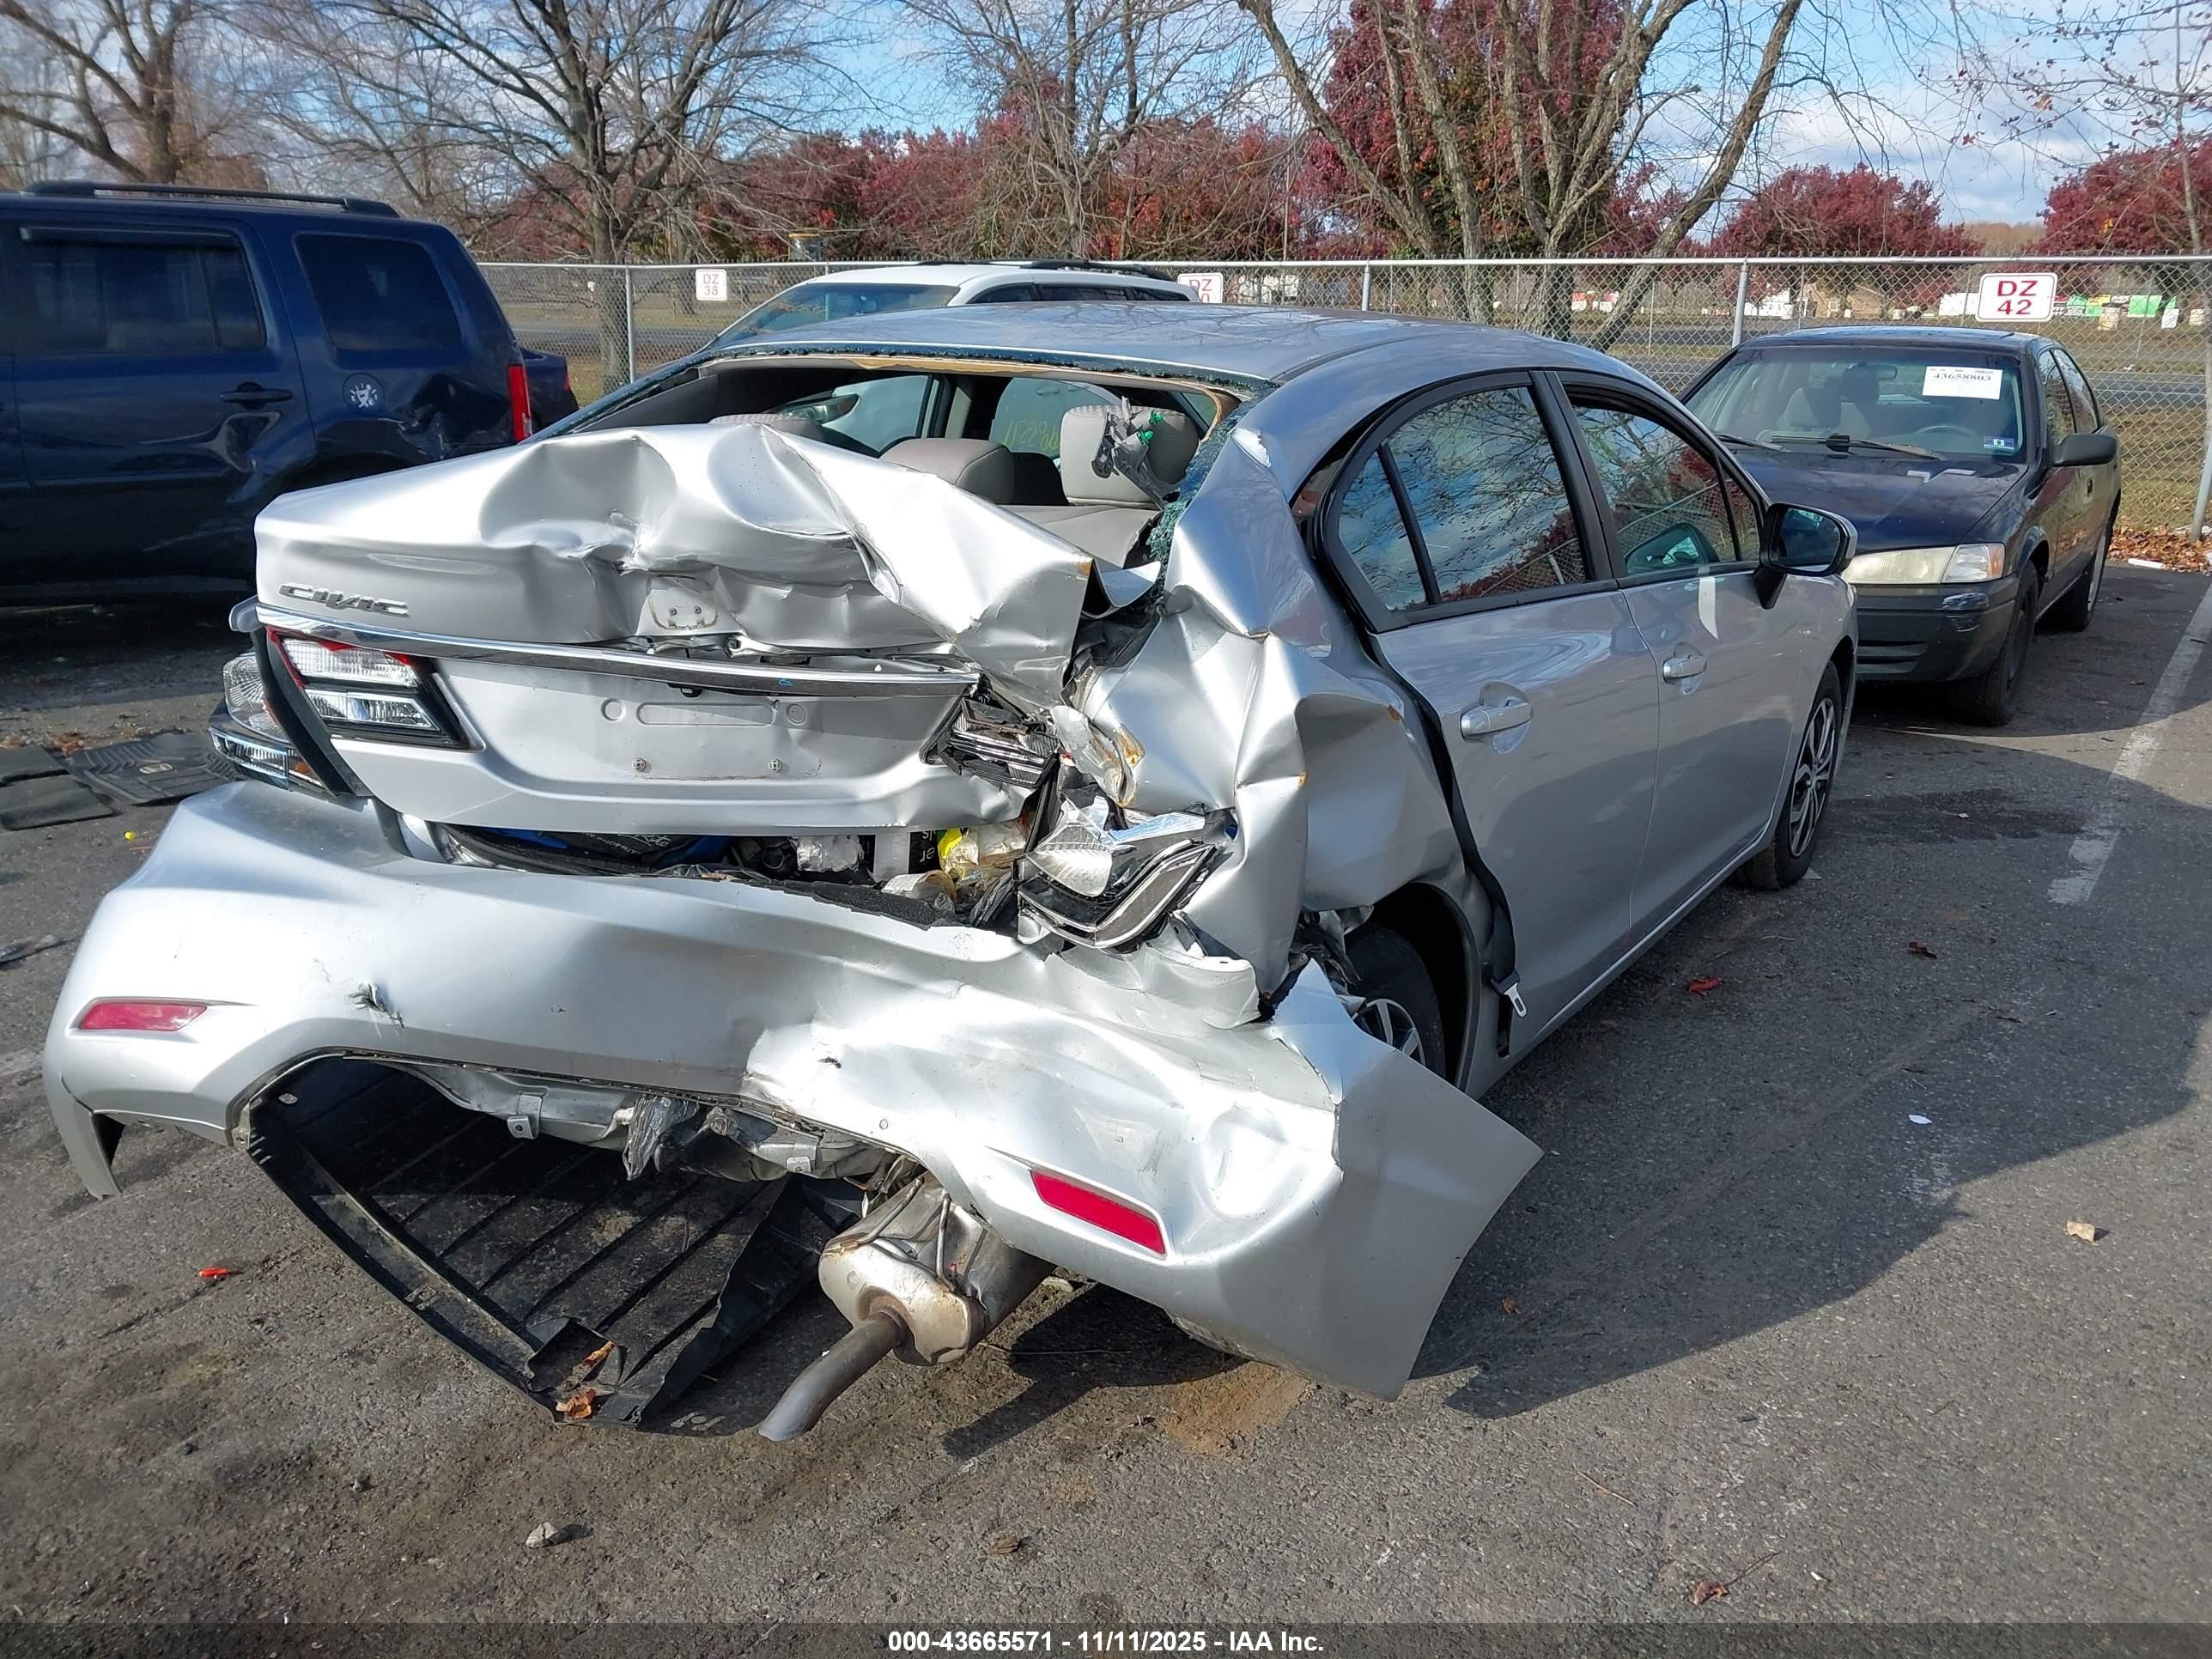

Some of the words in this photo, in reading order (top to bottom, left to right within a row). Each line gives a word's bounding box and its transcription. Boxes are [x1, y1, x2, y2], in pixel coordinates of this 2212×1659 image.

[703, 273, 720, 284] DZ
[1189, 279, 1212, 292] DZ
[1996, 280, 2039, 297] DZ
[1997, 299, 2033, 315] 42
[278, 581, 410, 618] CIVIC
